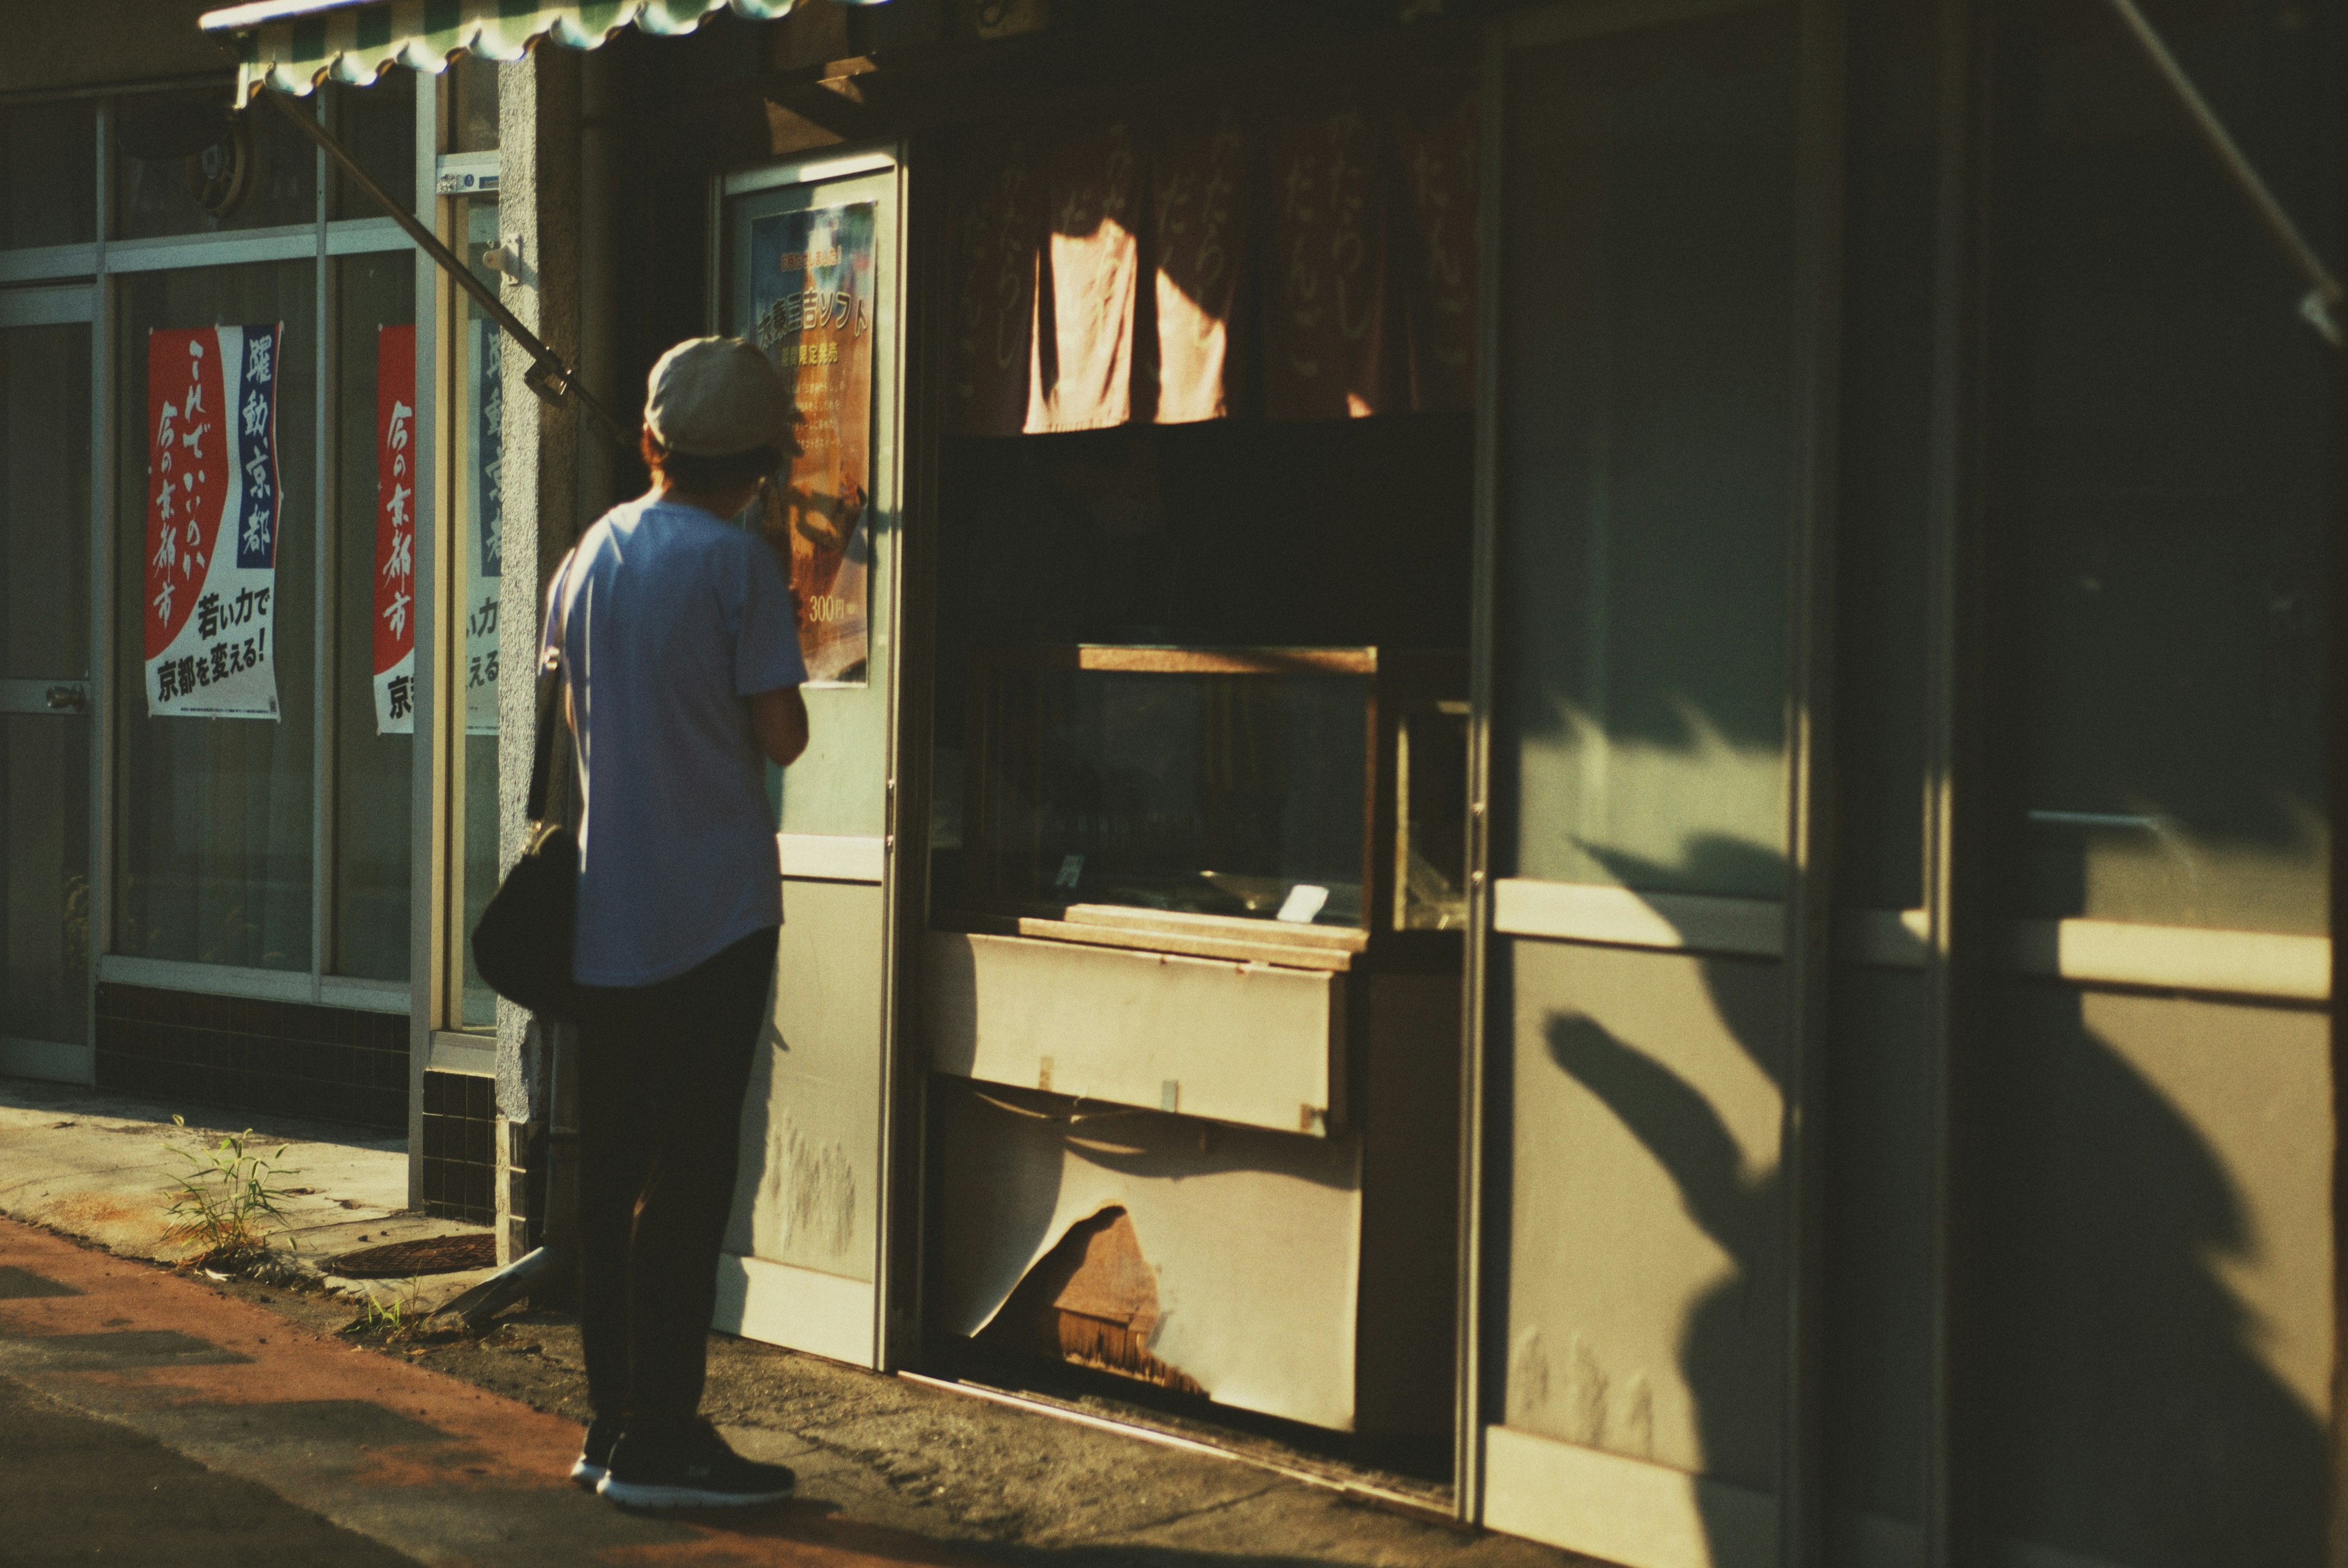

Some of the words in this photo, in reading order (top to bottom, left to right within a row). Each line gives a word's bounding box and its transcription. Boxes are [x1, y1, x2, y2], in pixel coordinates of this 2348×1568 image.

[152, 400, 178, 628] 今の京都市
[183, 339, 212, 581] これでいいのか
[382, 399, 413, 642] 今の京都市
[198, 586, 271, 641] 若い力で
